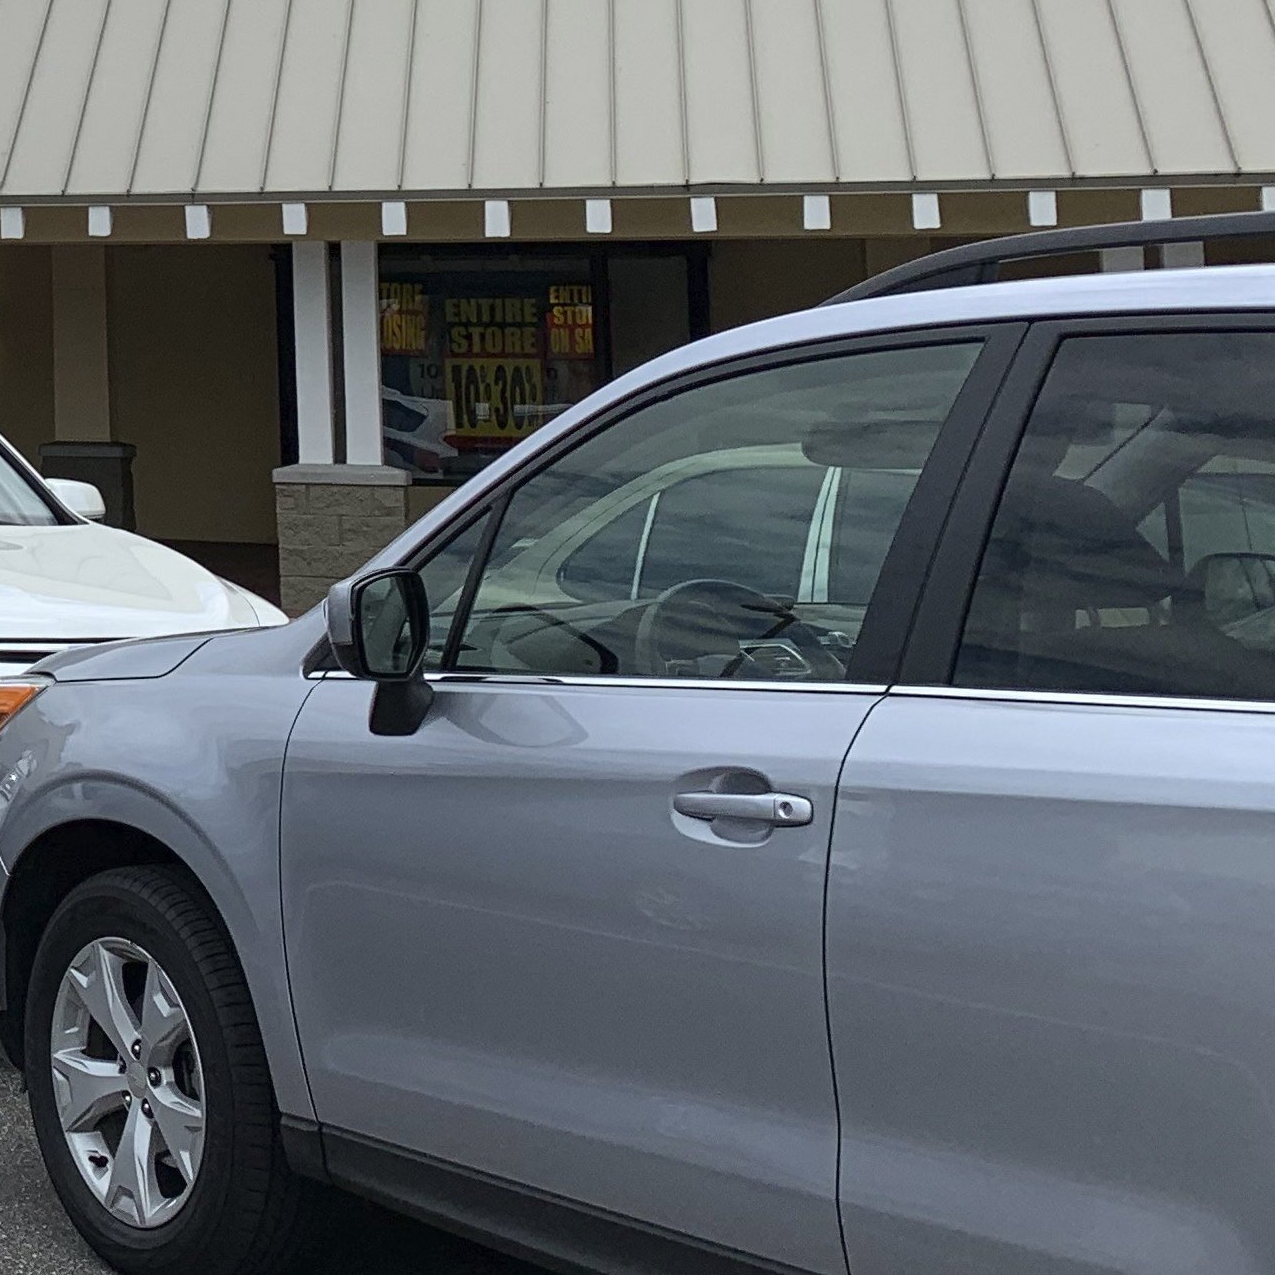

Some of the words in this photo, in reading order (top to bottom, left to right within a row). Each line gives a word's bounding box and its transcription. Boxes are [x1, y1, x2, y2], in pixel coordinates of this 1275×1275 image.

[379, 283, 423, 310] TORE
[549, 286, 592, 303] ENTI
[445, 299, 538, 322] ENTIRE
[553, 306, 593, 325] STO
[451, 327, 538, 353] STORE
[574, 328, 594, 354] SA
